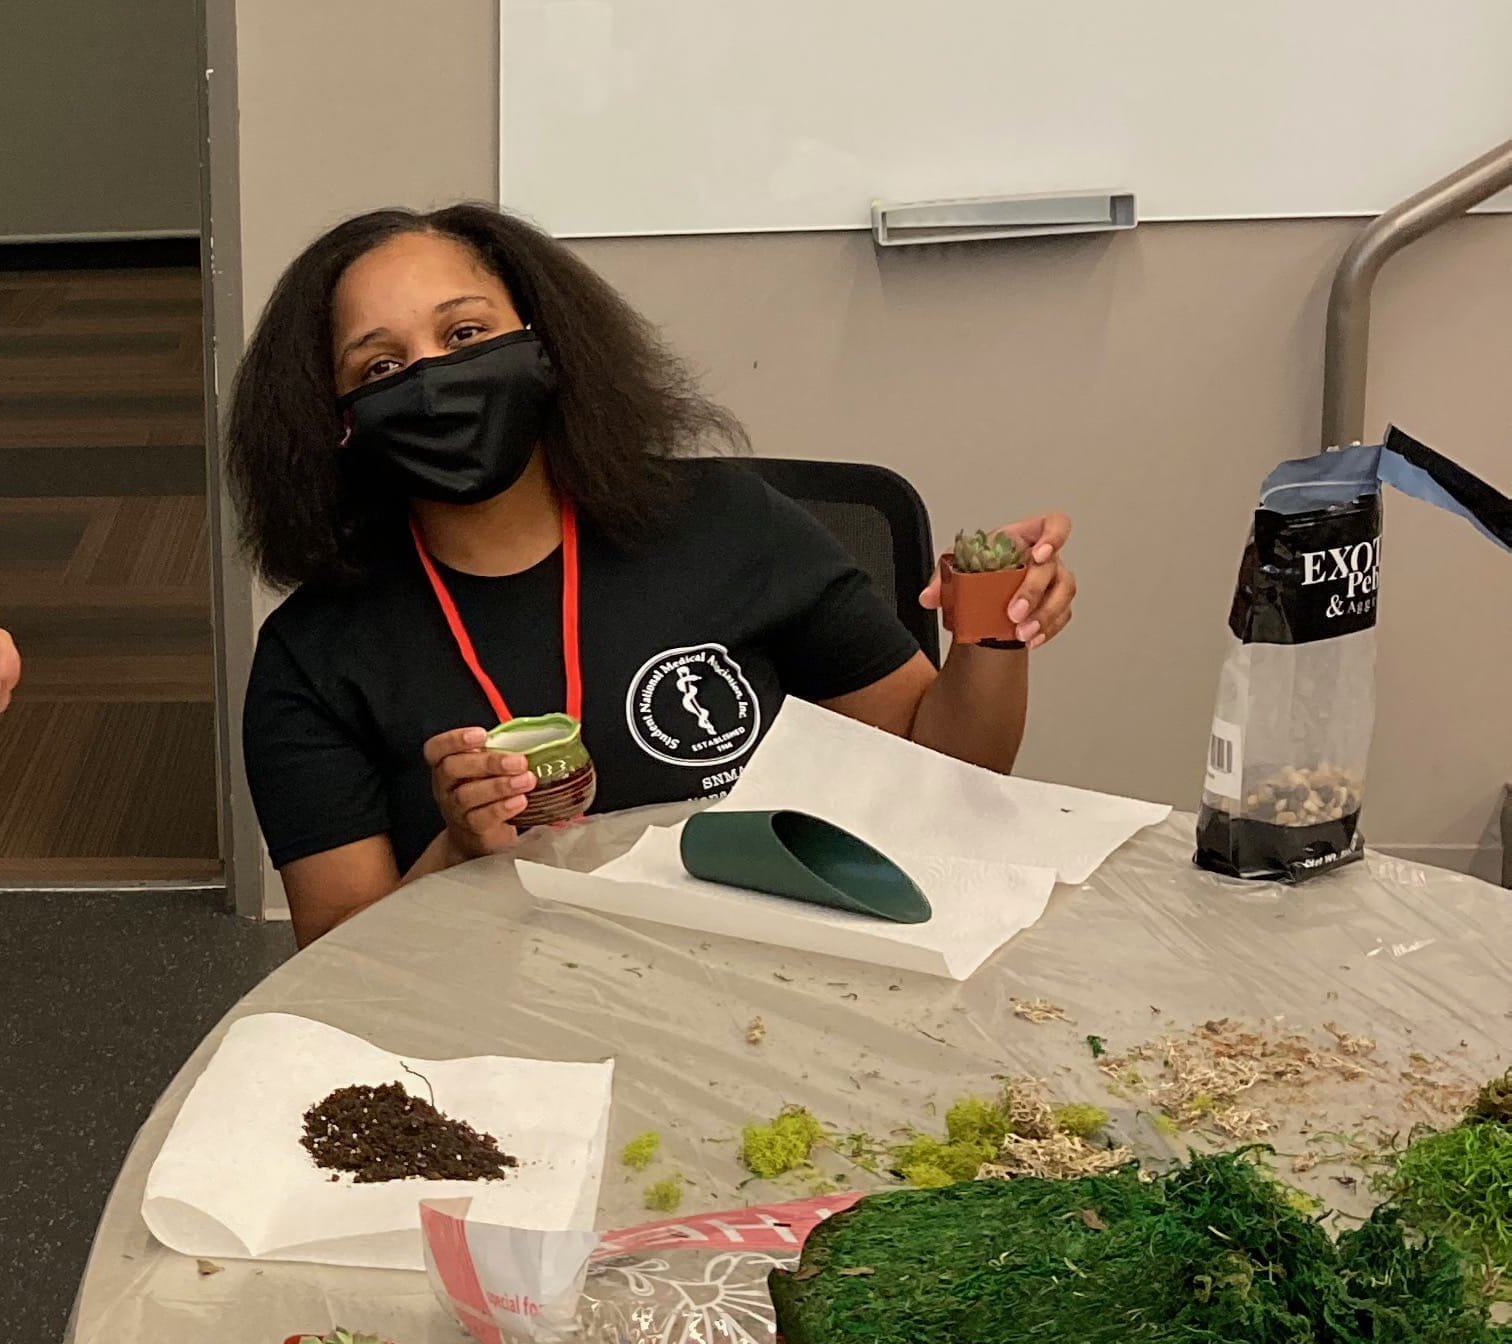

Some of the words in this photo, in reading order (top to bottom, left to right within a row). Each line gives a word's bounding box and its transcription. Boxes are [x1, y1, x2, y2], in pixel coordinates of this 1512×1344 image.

[1325, 593, 1345, 618] &
[659, 651, 706, 674] Medical
[639, 669, 665, 713] National
[642, 714, 681, 750] Student
